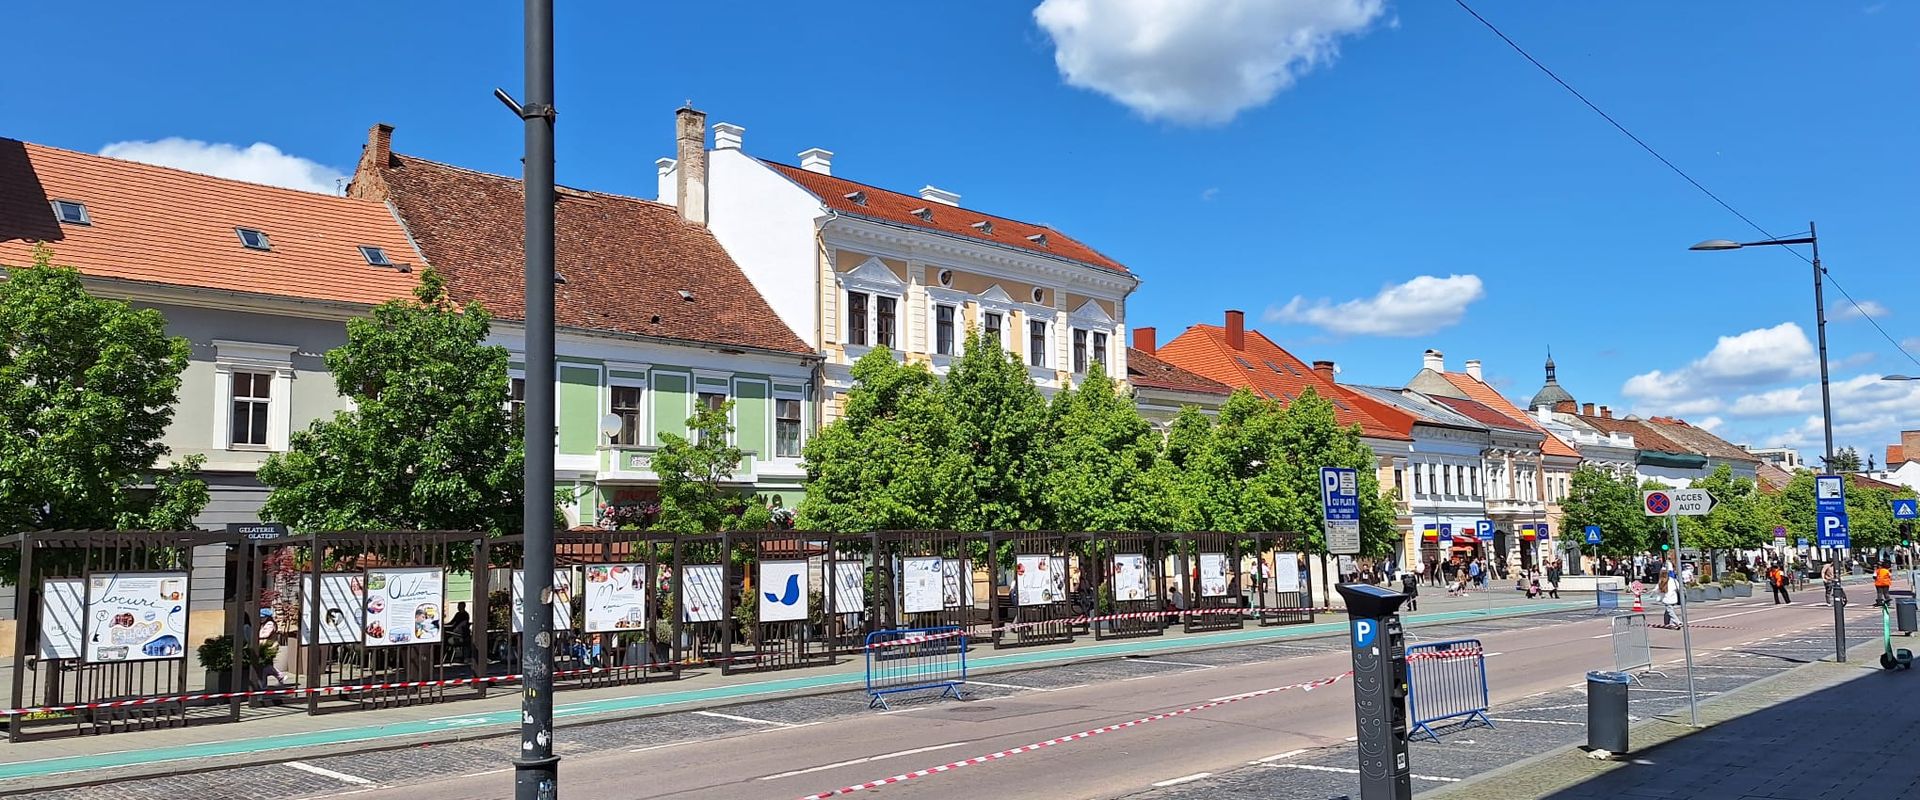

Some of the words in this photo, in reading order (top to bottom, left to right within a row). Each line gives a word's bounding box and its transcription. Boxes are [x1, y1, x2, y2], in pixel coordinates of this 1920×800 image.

[1324, 470, 1339, 507] P
[1675, 493, 1703, 502] ACCES
[1679, 503, 1701, 511] AUTO
[1478, 522, 1491, 536] P
[1824, 516, 1840, 537] P
[1357, 621, 1371, 642] P
